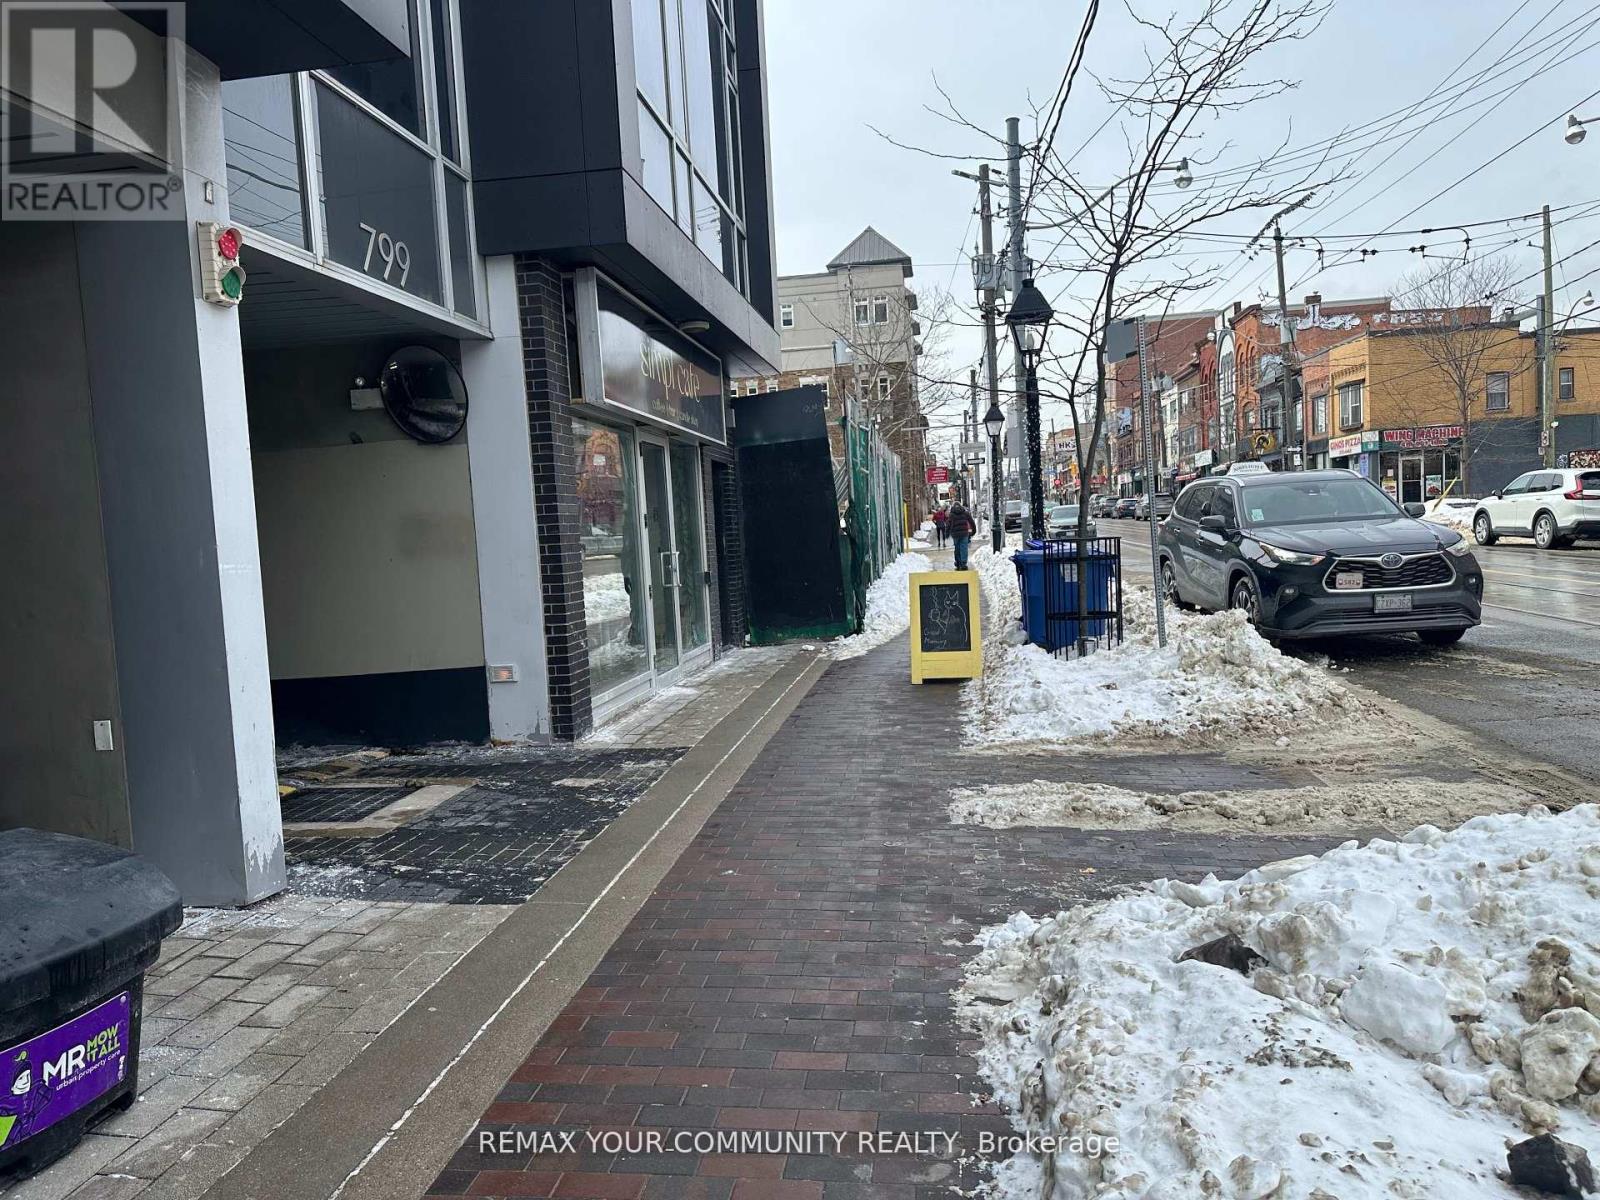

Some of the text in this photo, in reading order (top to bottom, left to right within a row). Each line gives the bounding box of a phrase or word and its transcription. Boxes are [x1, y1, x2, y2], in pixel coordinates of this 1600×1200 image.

[360, 222, 411, 288] 799
[1345, 436, 1361, 448] PIZZA
[1384, 429, 1413, 442] WING
[87, 1022, 119, 1052] MOW
[98, 1036, 120, 1059] ALL
[43, 1044, 86, 1086] MR
[56, 1075, 79, 1091] urban
[78, 1058, 107, 1081] property
